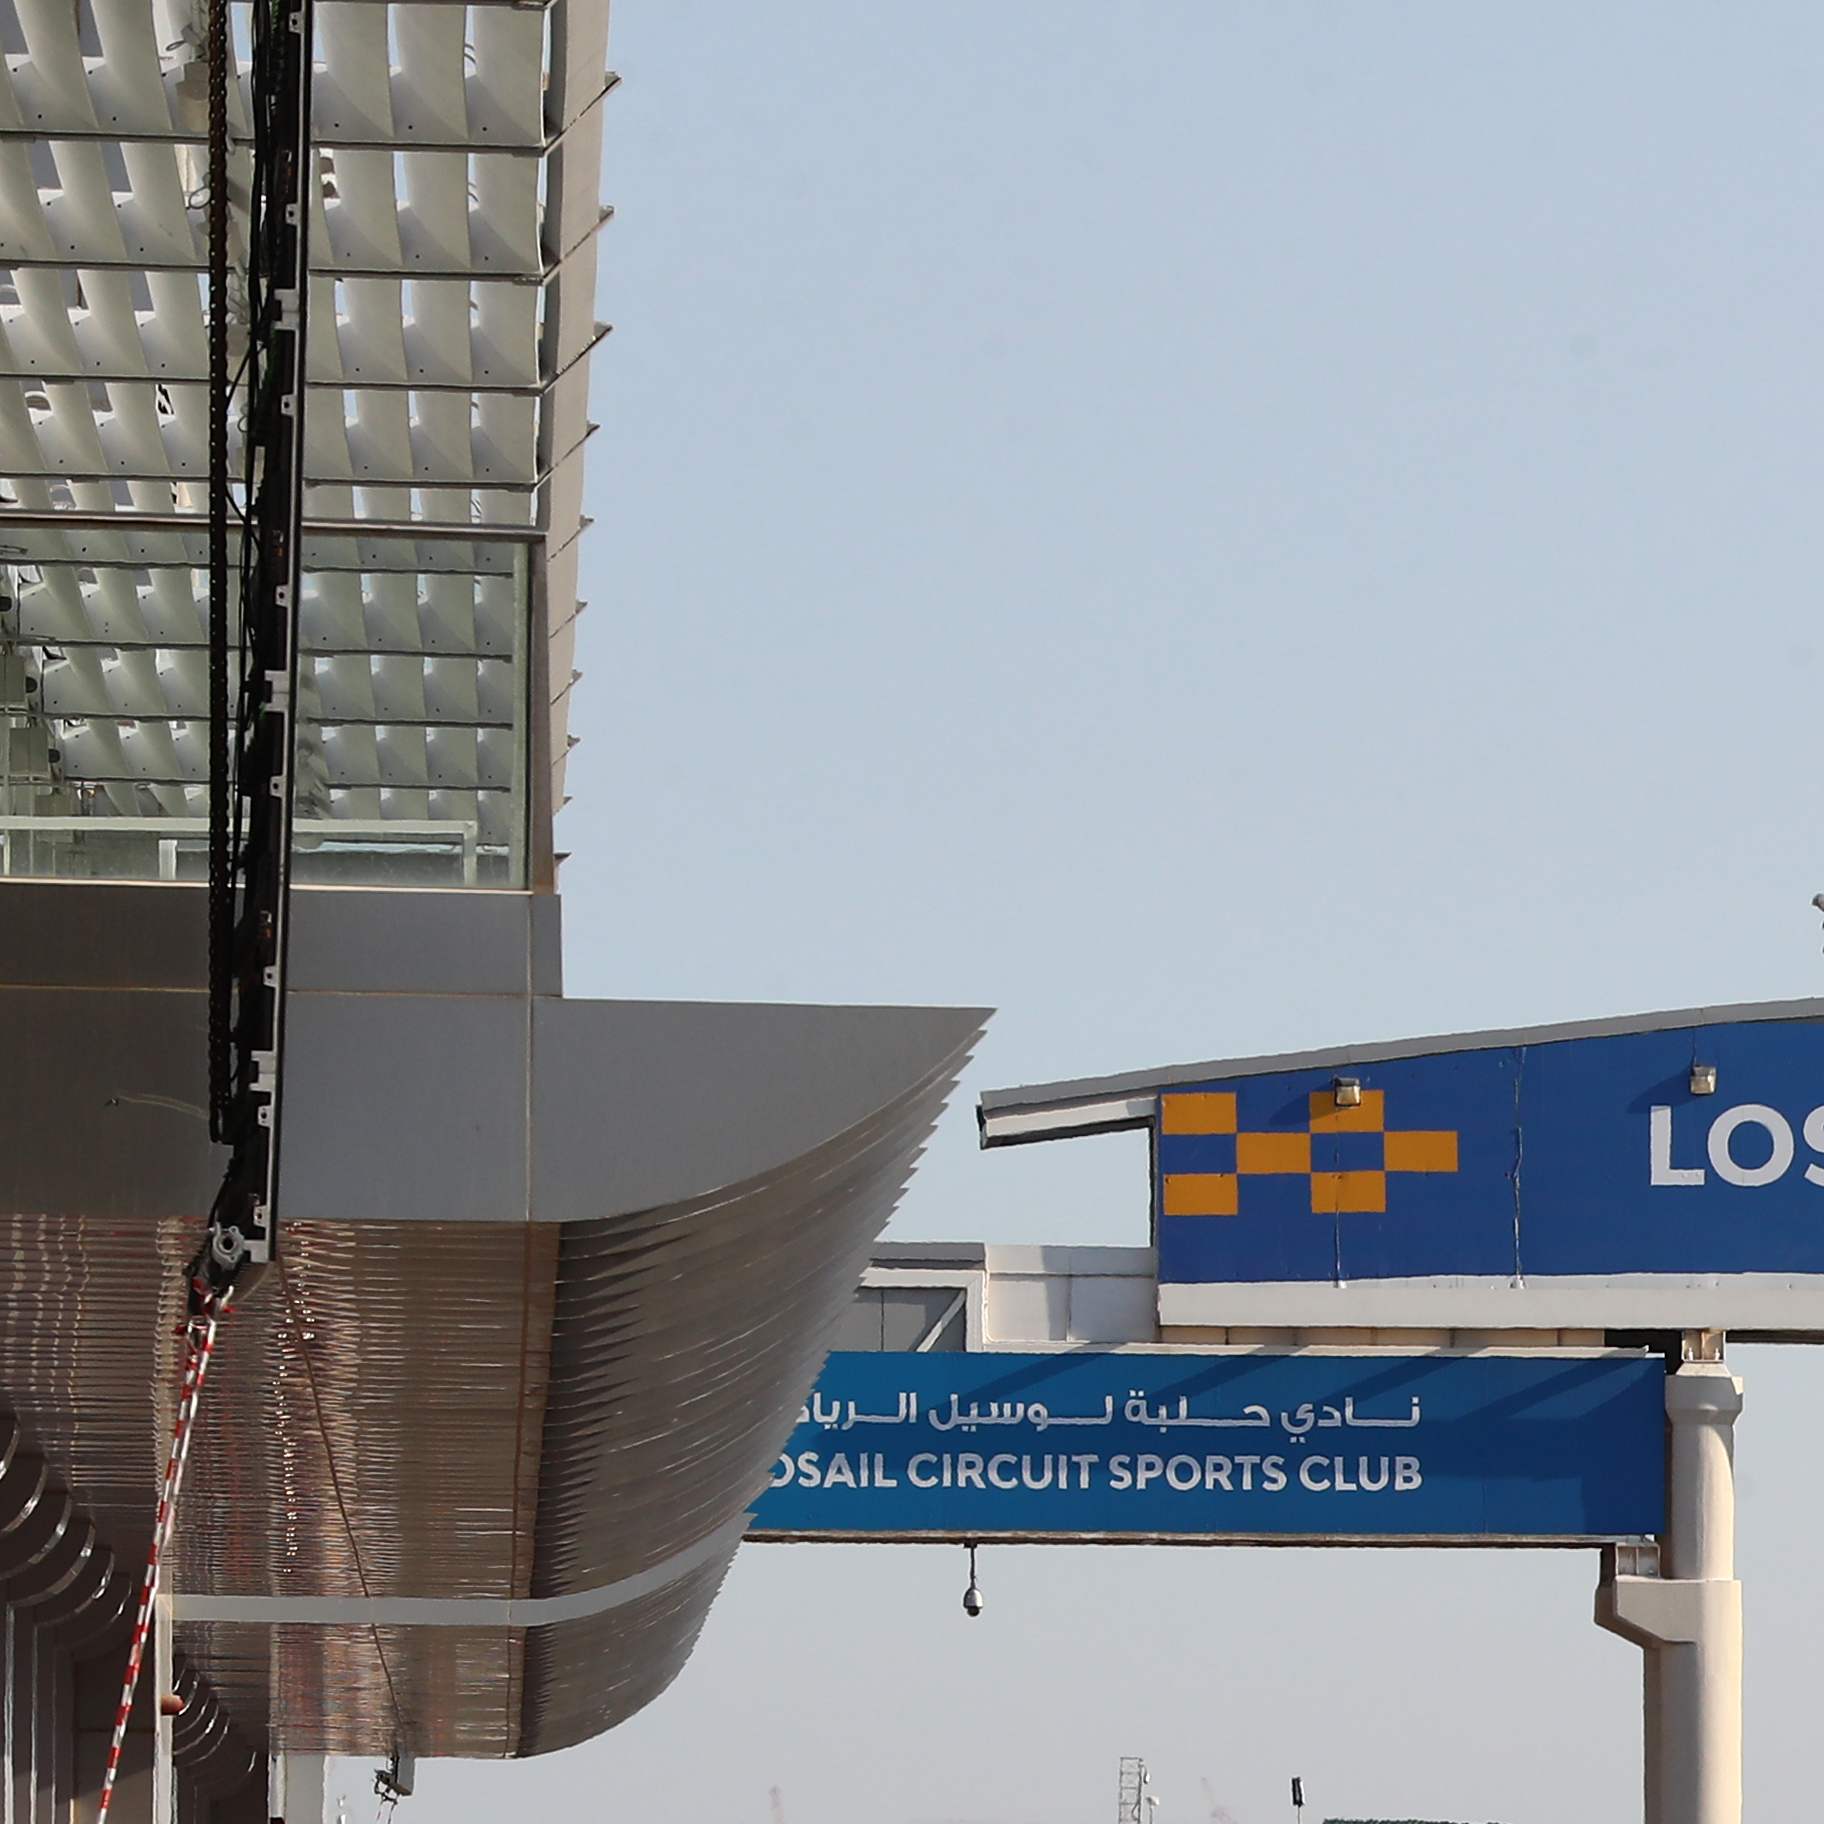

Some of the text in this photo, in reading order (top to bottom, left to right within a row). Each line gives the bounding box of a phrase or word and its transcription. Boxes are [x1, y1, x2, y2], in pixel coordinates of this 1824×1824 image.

[796, 1390, 1421, 1443] نادي حلبة لوسيل الريا
[768, 1451, 1423, 1491] OSAIL CIRCUIT SPORTS CLUB
